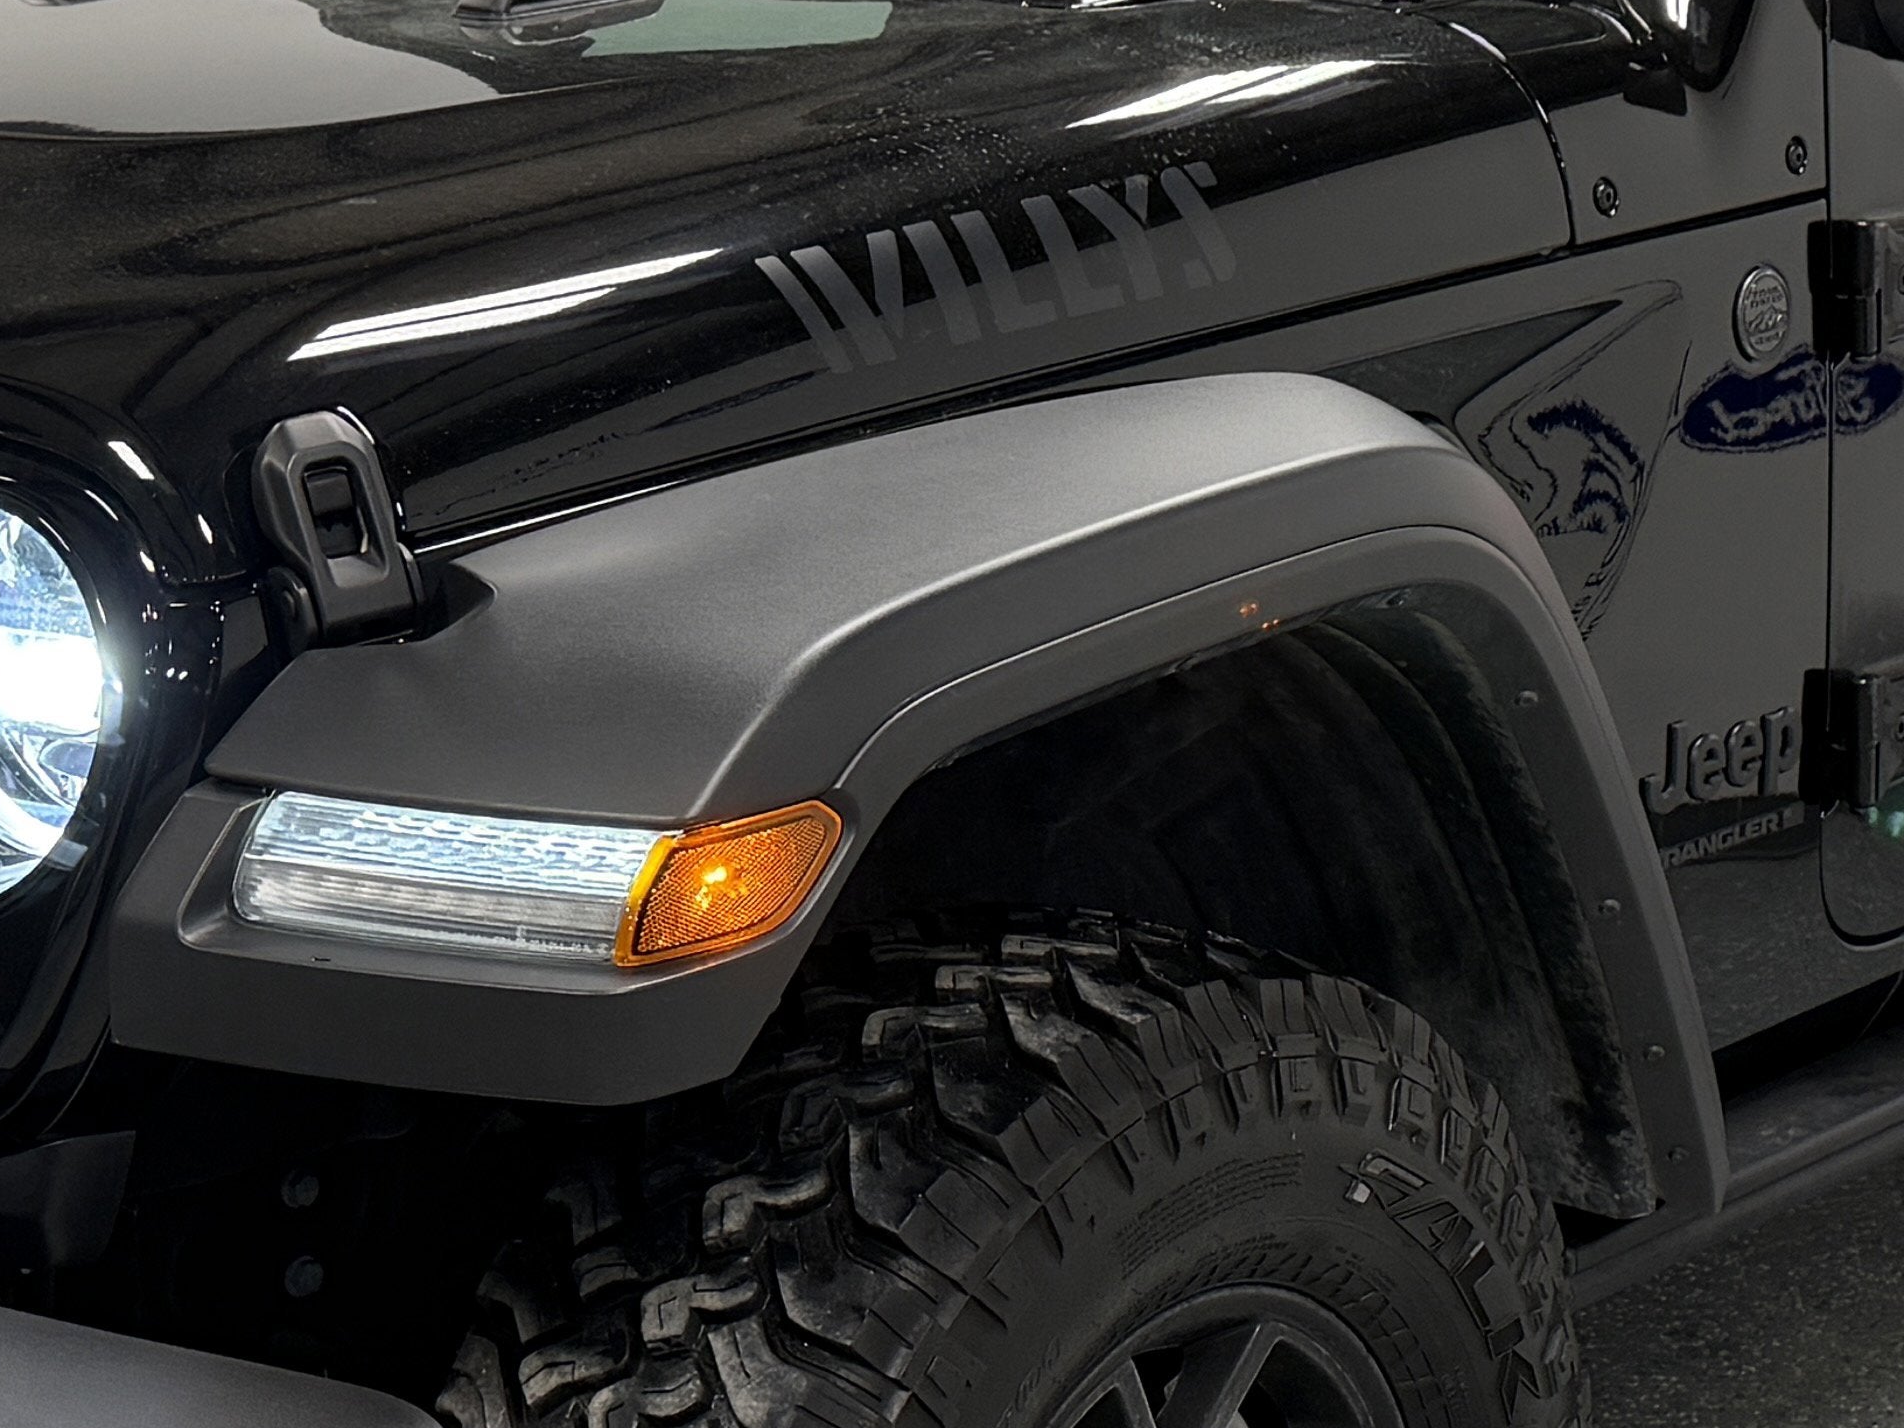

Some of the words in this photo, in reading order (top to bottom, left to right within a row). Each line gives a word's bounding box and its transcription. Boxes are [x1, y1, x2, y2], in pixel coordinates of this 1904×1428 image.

[755, 160, 1238, 375] WILLYS
[1639, 706, 1802, 816] Jeep
[1661, 813, 1780, 869] RANGLER
